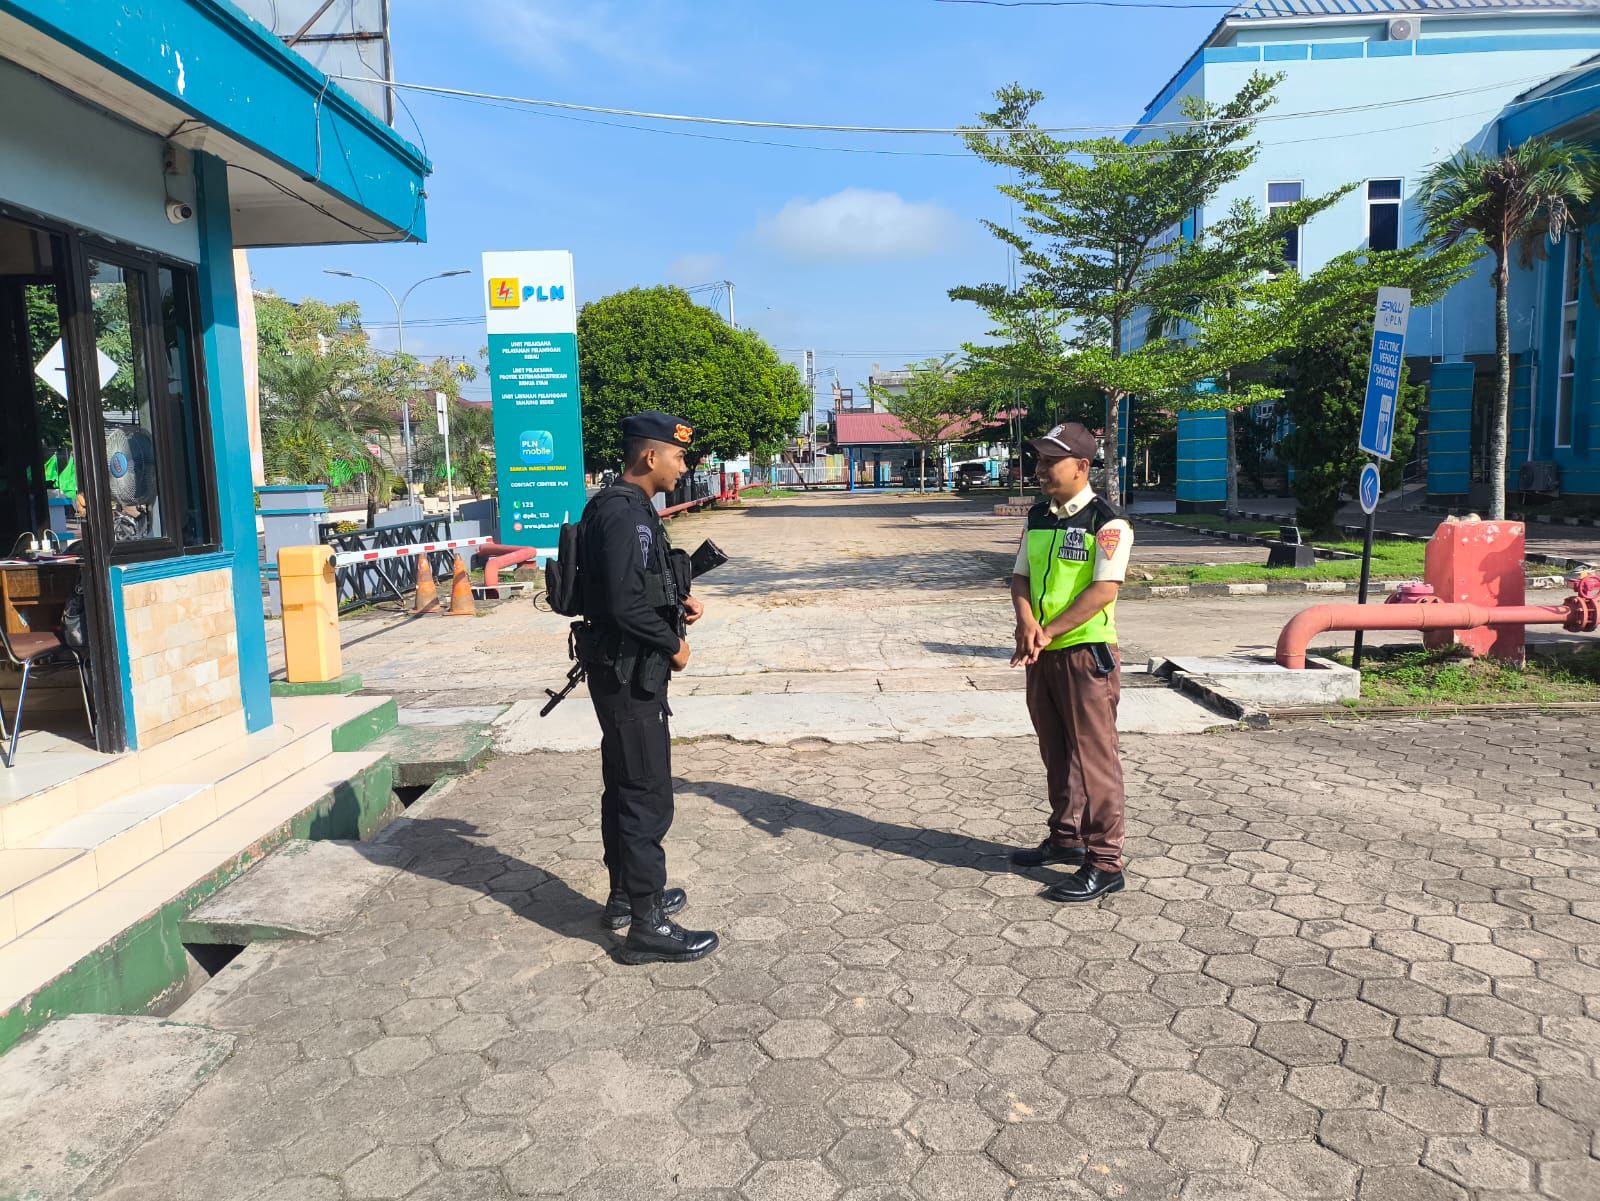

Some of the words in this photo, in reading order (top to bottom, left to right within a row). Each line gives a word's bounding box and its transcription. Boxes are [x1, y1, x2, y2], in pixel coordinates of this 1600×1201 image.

[522, 285, 564, 302] PLN
[1379, 340, 1400, 353] ELECTRIC
[1379, 352, 1399, 365] VEHICLE
[1373, 363, 1397, 378] CHARGING
[1375, 376, 1395, 390] STATION
[521, 440, 538, 448] PLN
[522, 447, 551, 455] mobile
[1059, 549, 1087, 561] SECURITY
